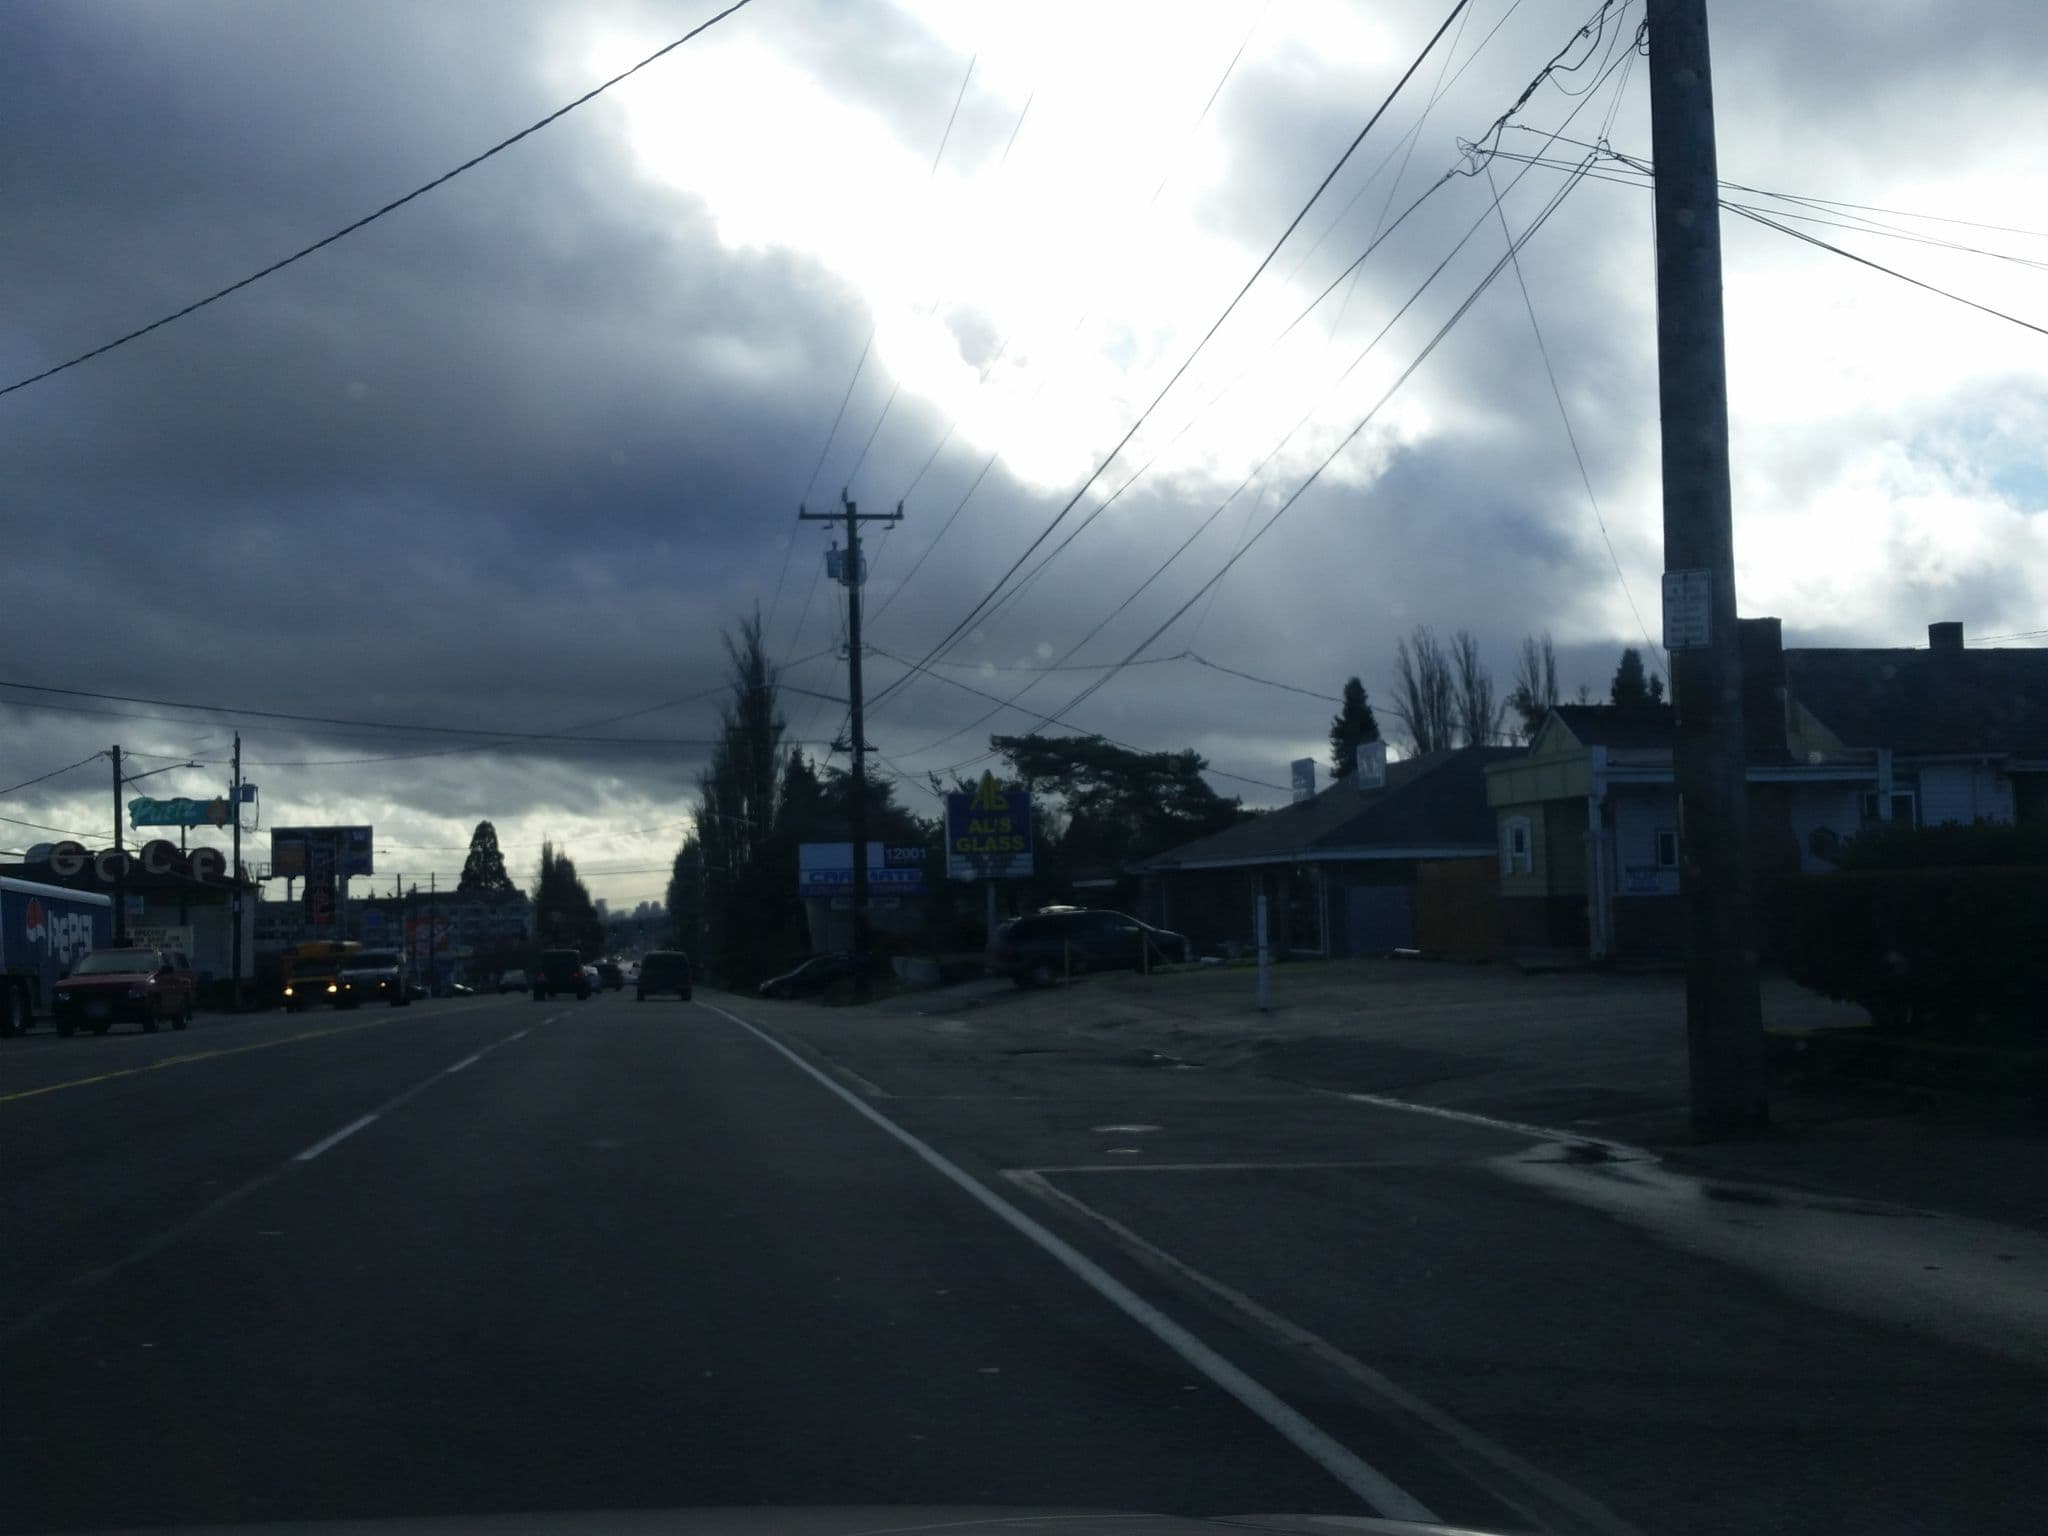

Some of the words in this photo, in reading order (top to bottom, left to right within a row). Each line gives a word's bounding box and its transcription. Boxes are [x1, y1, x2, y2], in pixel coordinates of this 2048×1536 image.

[968, 818, 1012, 833] AL'S
[956, 835, 1025, 852] GLASS
[886, 847, 927, 859] 12001
